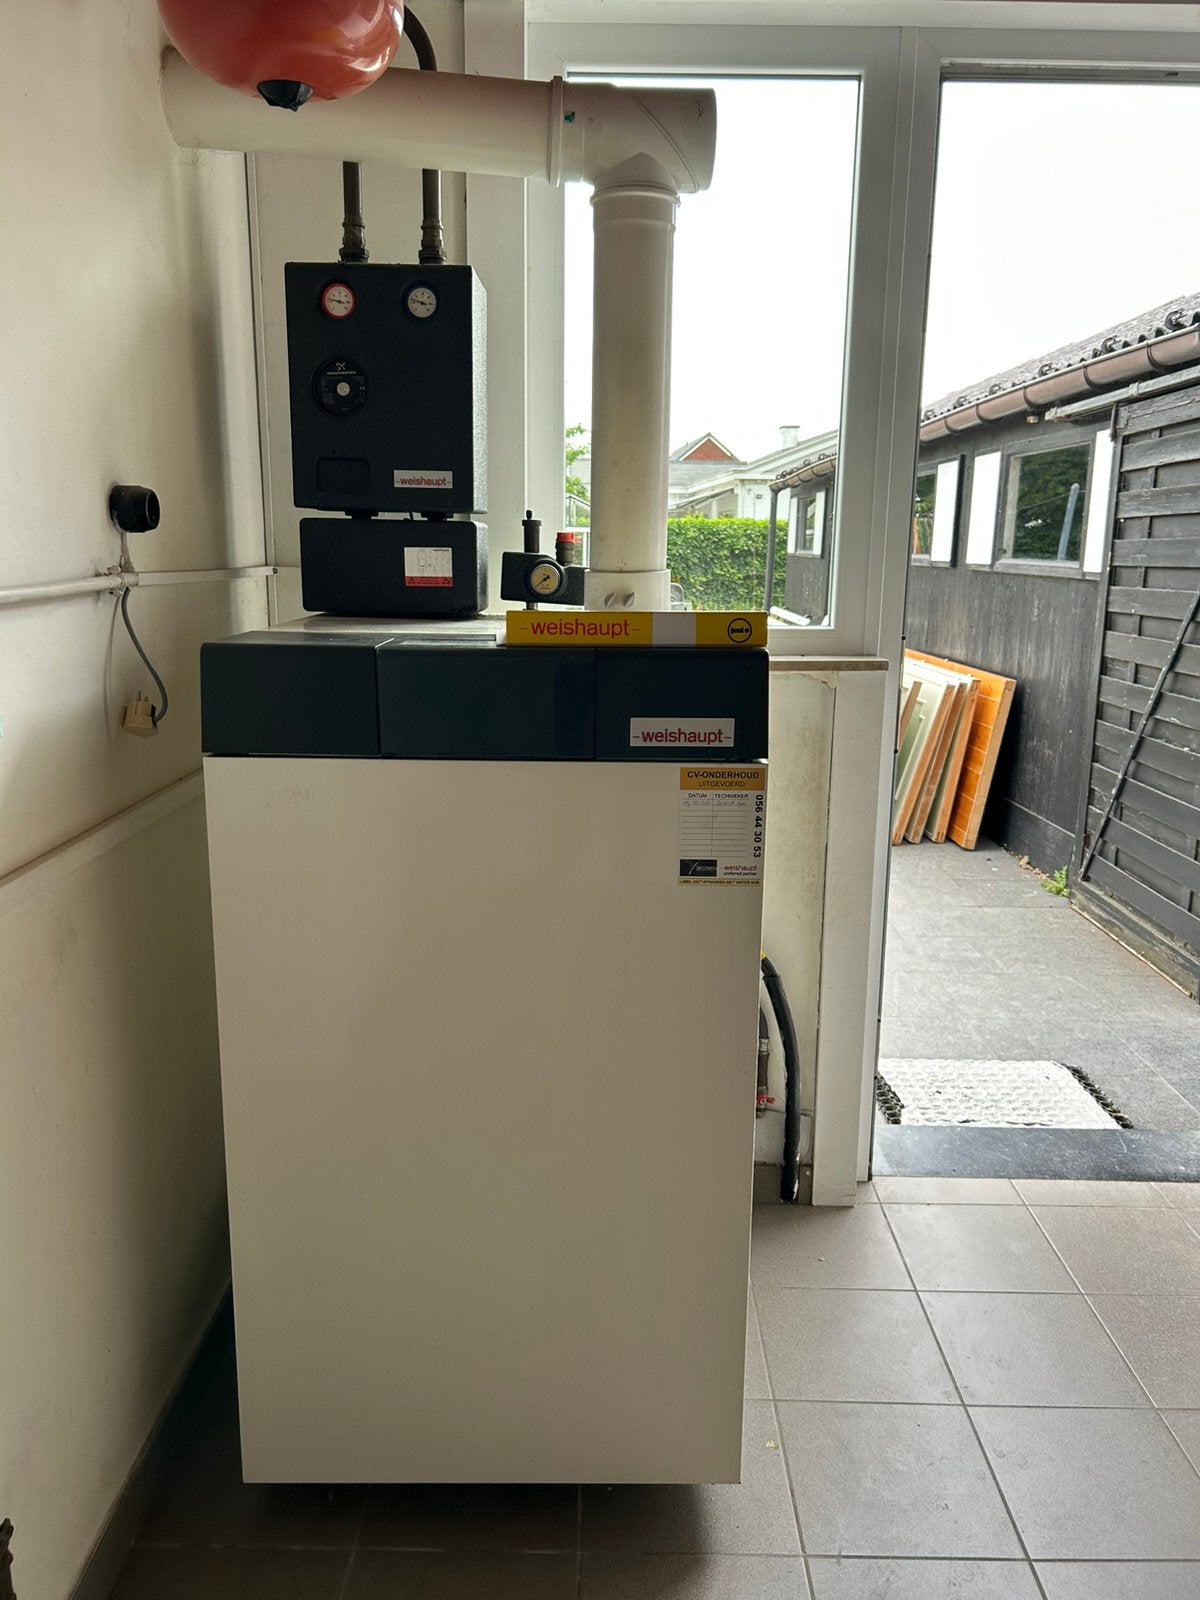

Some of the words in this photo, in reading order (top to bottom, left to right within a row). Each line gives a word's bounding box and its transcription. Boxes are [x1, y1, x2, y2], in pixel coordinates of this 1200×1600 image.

[687, 770, 760, 779] CV-ONDERHOUD
[699, 780, 746, 788] UITGEVOERD
[755, 794, 764, 813] 056
[754, 815, 763, 828] 44
[754, 830, 763, 843] 30
[753, 845, 762, 858] 53
